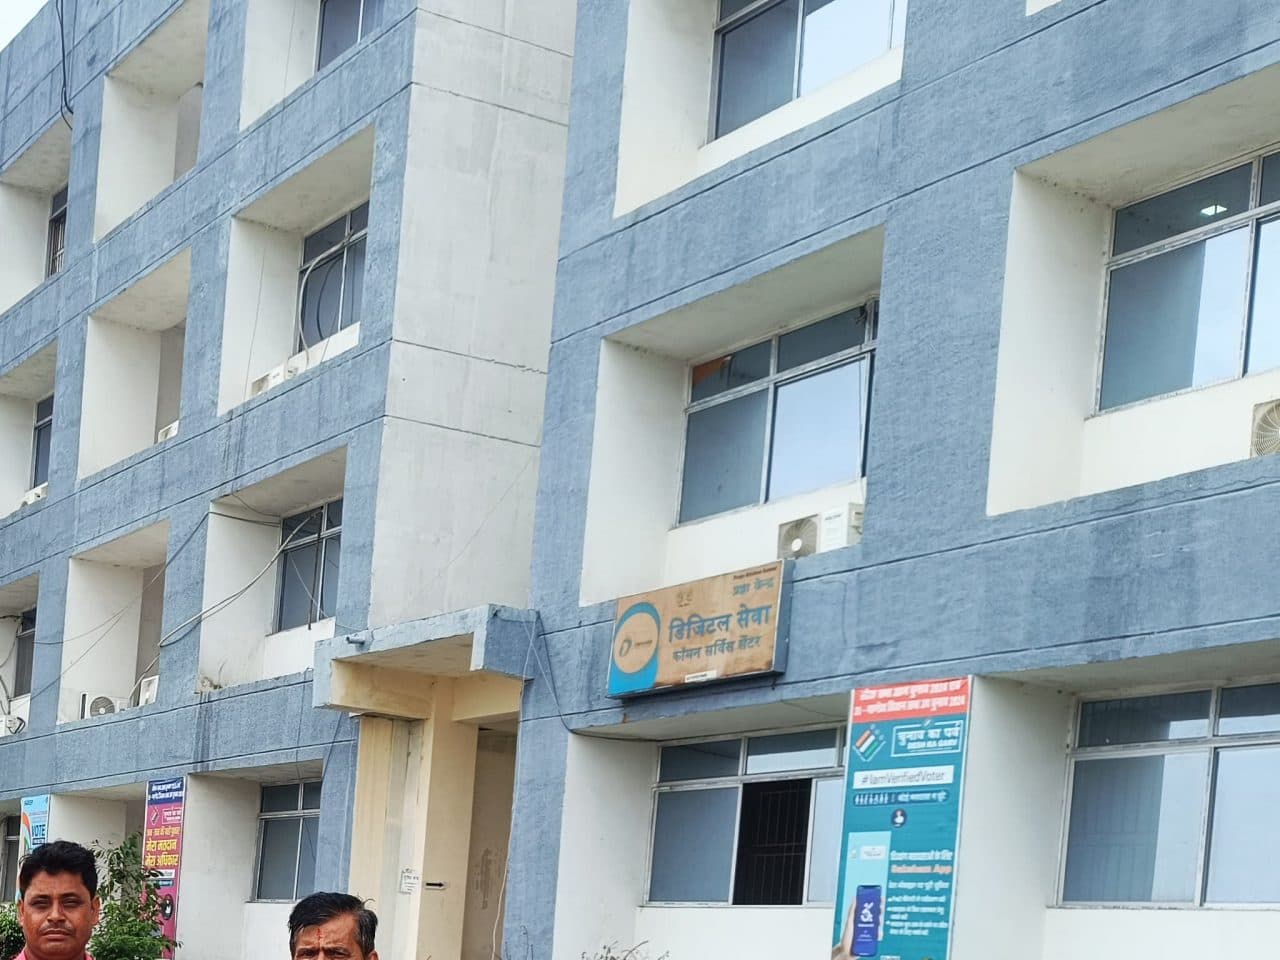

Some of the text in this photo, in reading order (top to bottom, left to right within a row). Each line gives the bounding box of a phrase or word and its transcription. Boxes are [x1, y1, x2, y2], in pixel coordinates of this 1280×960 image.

[669, 603, 772, 643] डिजिटल सेवा
[705, 637, 735, 656] सर्विस
[896, 730, 926, 747] चुनाव
[927, 728, 942, 740] का
